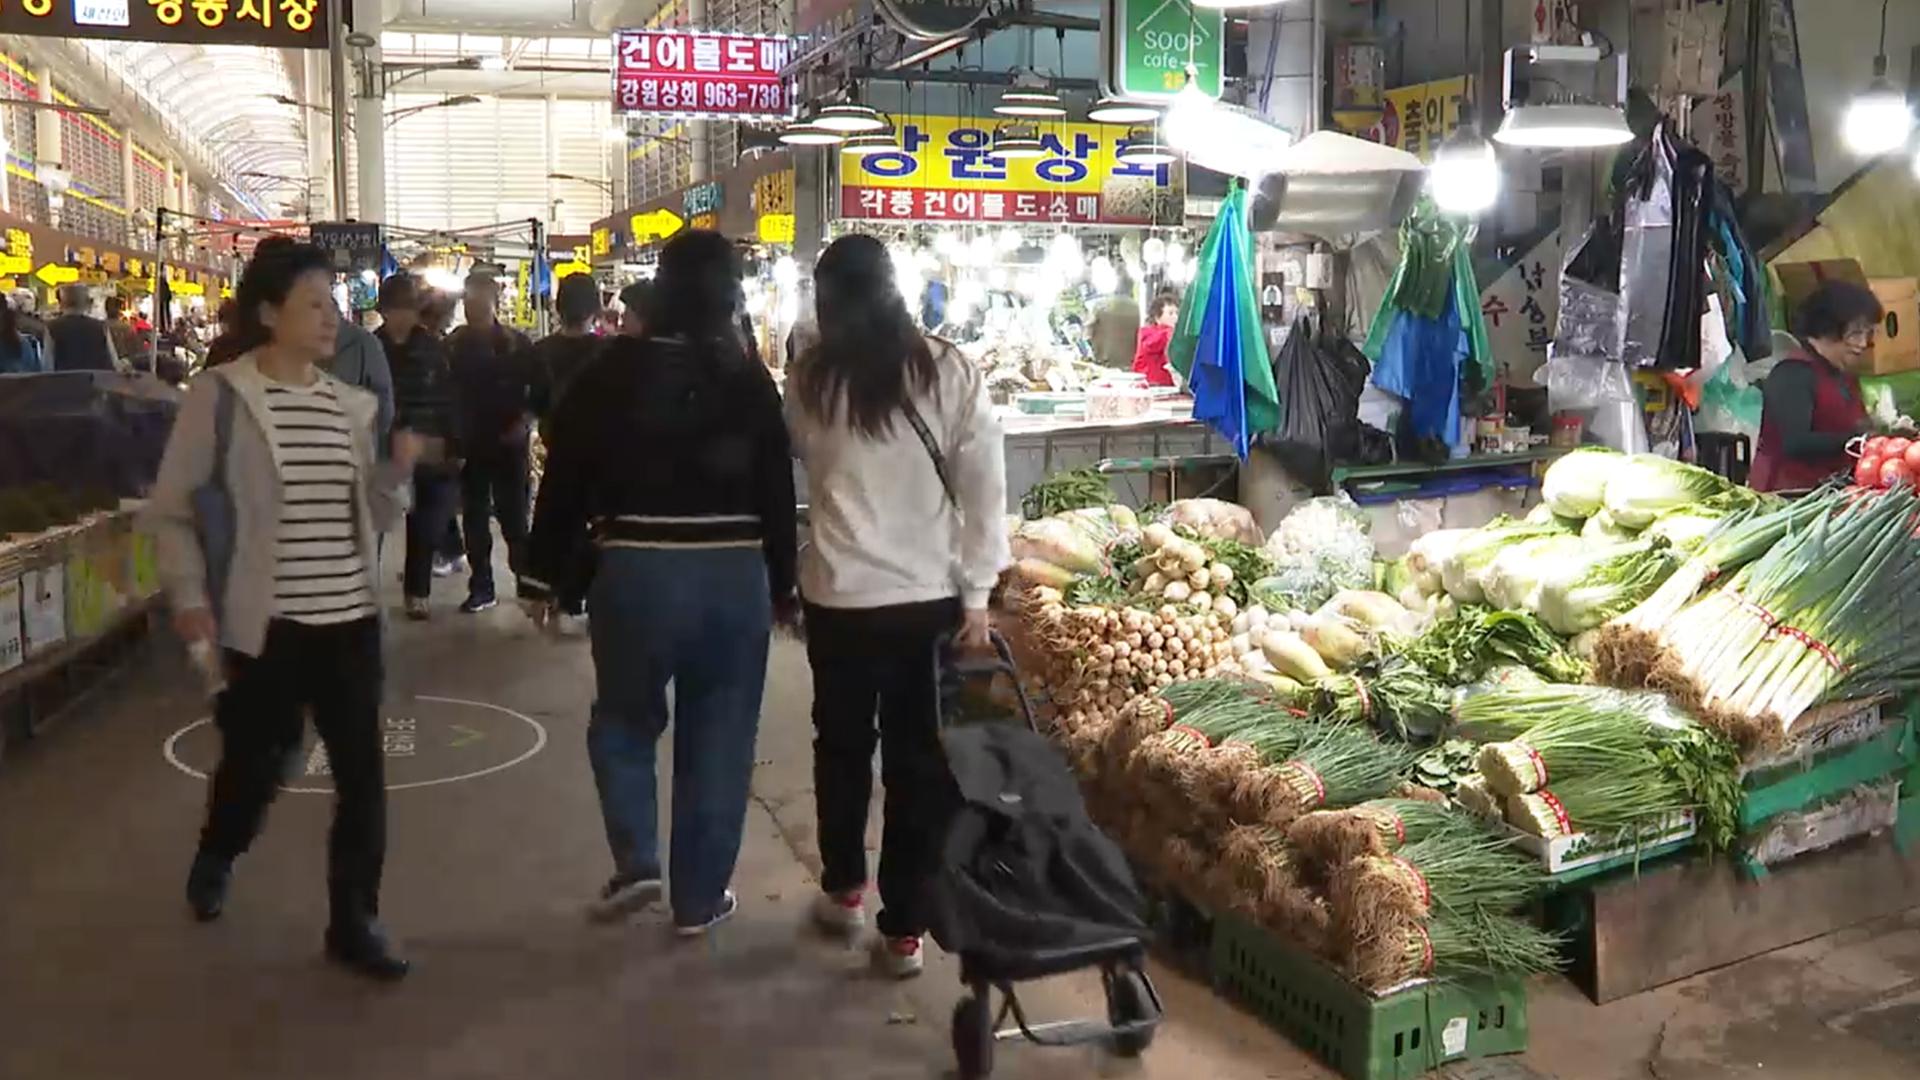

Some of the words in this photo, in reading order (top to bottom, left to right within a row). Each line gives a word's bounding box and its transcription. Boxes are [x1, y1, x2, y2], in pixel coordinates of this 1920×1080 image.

[621, 35, 788, 73] 건어물도매
[1144, 30, 1203, 52] SOOP
[1143, 52, 1178, 69] cafe
[622, 79, 697, 107] 강원상회
[860, 189, 913, 217] 각종
[923, 191, 1005, 218] 건어물
